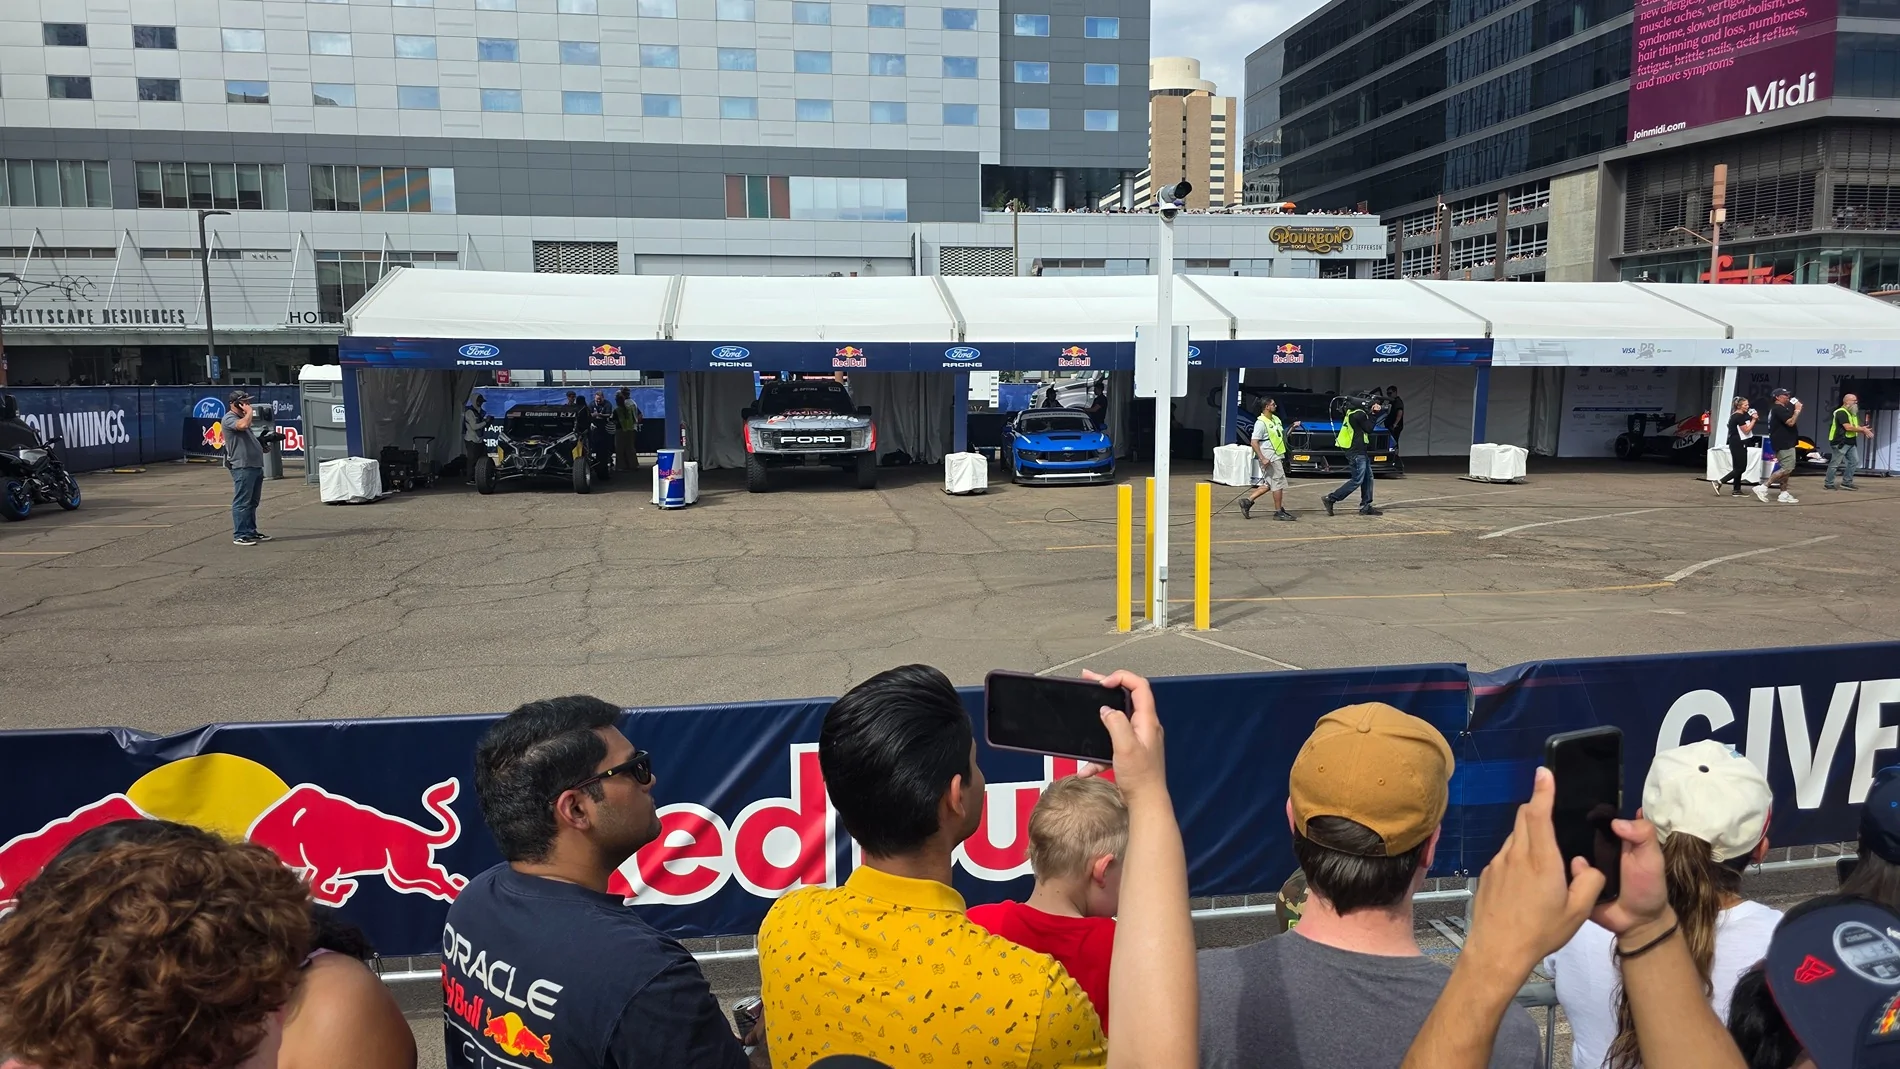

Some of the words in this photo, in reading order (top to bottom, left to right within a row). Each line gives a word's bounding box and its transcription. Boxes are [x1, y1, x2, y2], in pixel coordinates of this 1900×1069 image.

[1638, 28, 1686, 50] syndrome,
[1686, 14, 1720, 34] slowed
[1722, 0, 1785, 24] metabolism,
[1640, 7, 1660, 21] new
[1640, 17, 1672, 34] muscle
[1674, 9, 1705, 24] aches,
[1638, 48, 1657, 62] hair
[1659, 37, 1699, 57] thinning
[1701, 28, 1721, 44] and
[1724, 25, 1746, 39] loss,
[1748, 7, 1808, 31] numbness,
[1637, 60, 1673, 77] fatigue,
[1674, 50, 1705, 66] brittle
[1707, 41, 1734, 57] nails,
[1736, 32, 1759, 49] acid
[1762, 25, 1799, 42] reflux,
[1636, 76, 1654, 90] and
[1656, 71, 1681, 85] more
[1682, 57, 1735, 80] symptoms
[1745, 71, 1816, 116] Midi
[1633, 121, 1686, 141] joinmidi.com
[11, 309, 94, 324] CITYSCAPE
[102, 309, 185, 324] RESIDENCES
[589, 355, 607, 366] Red
[607, 355, 626, 366] Bull
[832, 357, 849, 367] Red
[850, 357, 867, 367] Bull
[1058, 357, 1074, 367] Red
[1075, 357, 1091, 367] Bull
[1273, 354, 1288, 363] Red
[1288, 354, 1304, 363] Bull
[1751, 373, 1770, 382] VISA
[59, 409, 130, 449] WIIINGS.
[780, 435, 846, 443] FORD
[1675, 435, 1694, 448] VISA
[608, 743, 836, 905] ed
[443, 922, 564, 1020] ORACLE
[454, 983, 484, 1031] Bull
